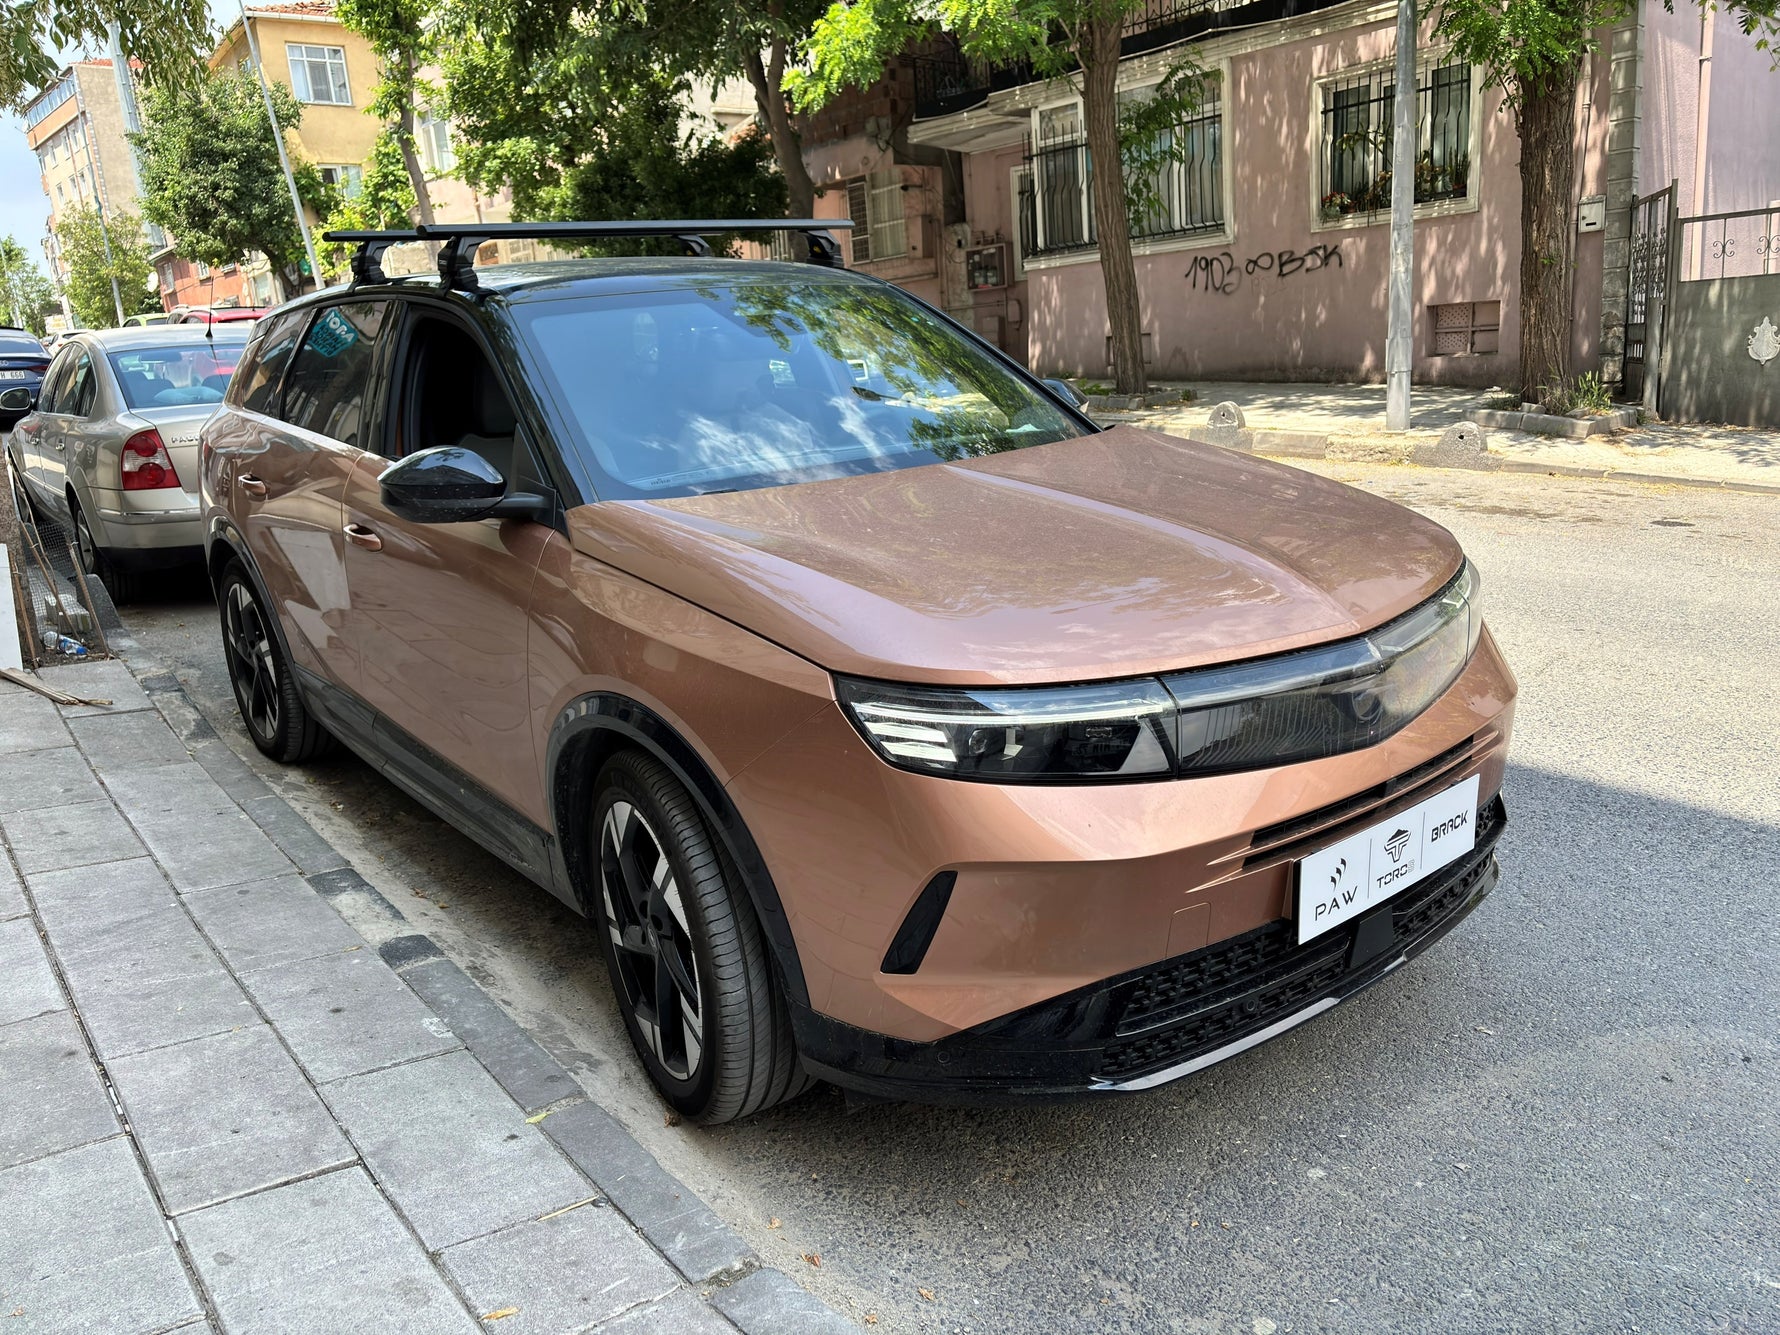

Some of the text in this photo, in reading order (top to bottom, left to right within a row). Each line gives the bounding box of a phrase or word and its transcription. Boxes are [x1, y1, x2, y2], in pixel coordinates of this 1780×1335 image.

[1185, 252, 1241, 295] 1903
[1431, 809, 1469, 843] BRACK
[1315, 885, 1358, 922] PAW
